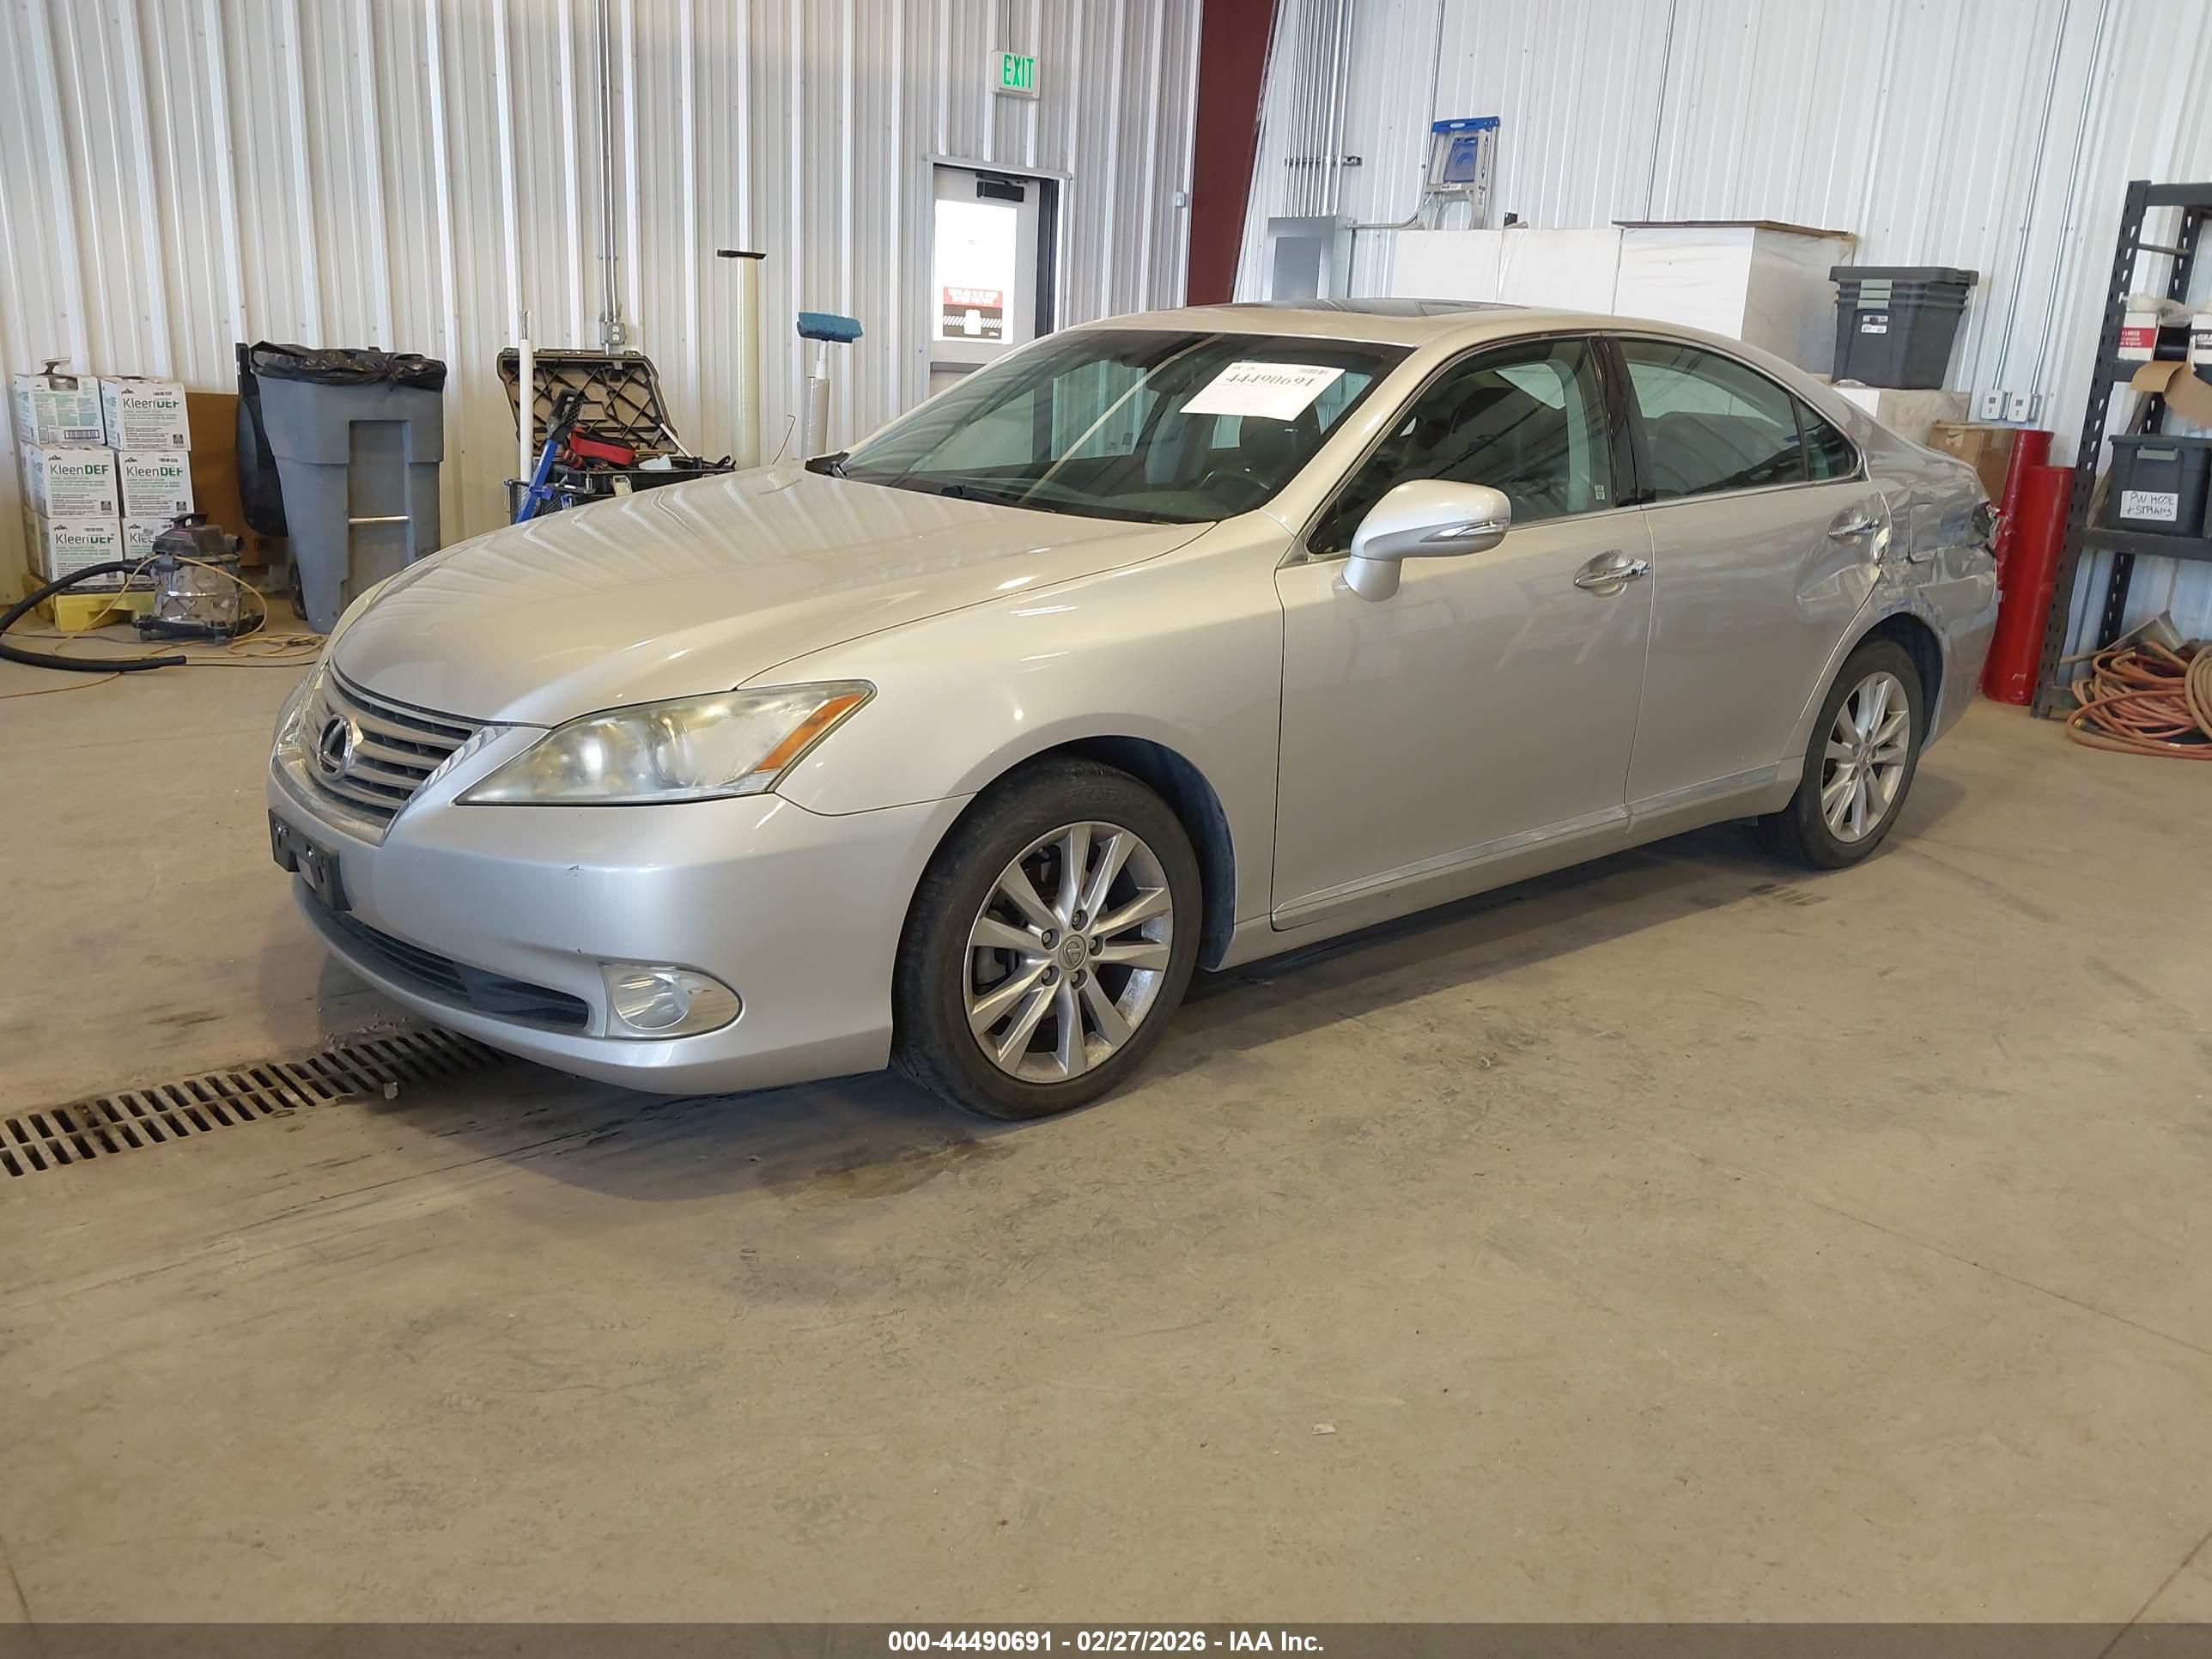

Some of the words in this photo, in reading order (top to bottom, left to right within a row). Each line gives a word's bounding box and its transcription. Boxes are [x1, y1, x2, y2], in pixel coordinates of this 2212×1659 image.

[1004, 54, 1034, 88] EXIT
[1226, 374, 1316, 386] 44490691
[123, 398, 179, 409] KleenDEF
[50, 464, 110, 475] KleenDEF
[126, 466, 183, 477] KleenDEF
[2130, 491, 2147, 503] PW
[2150, 495, 2174, 505] HOSE
[55, 533, 114, 544] KleenDEF
